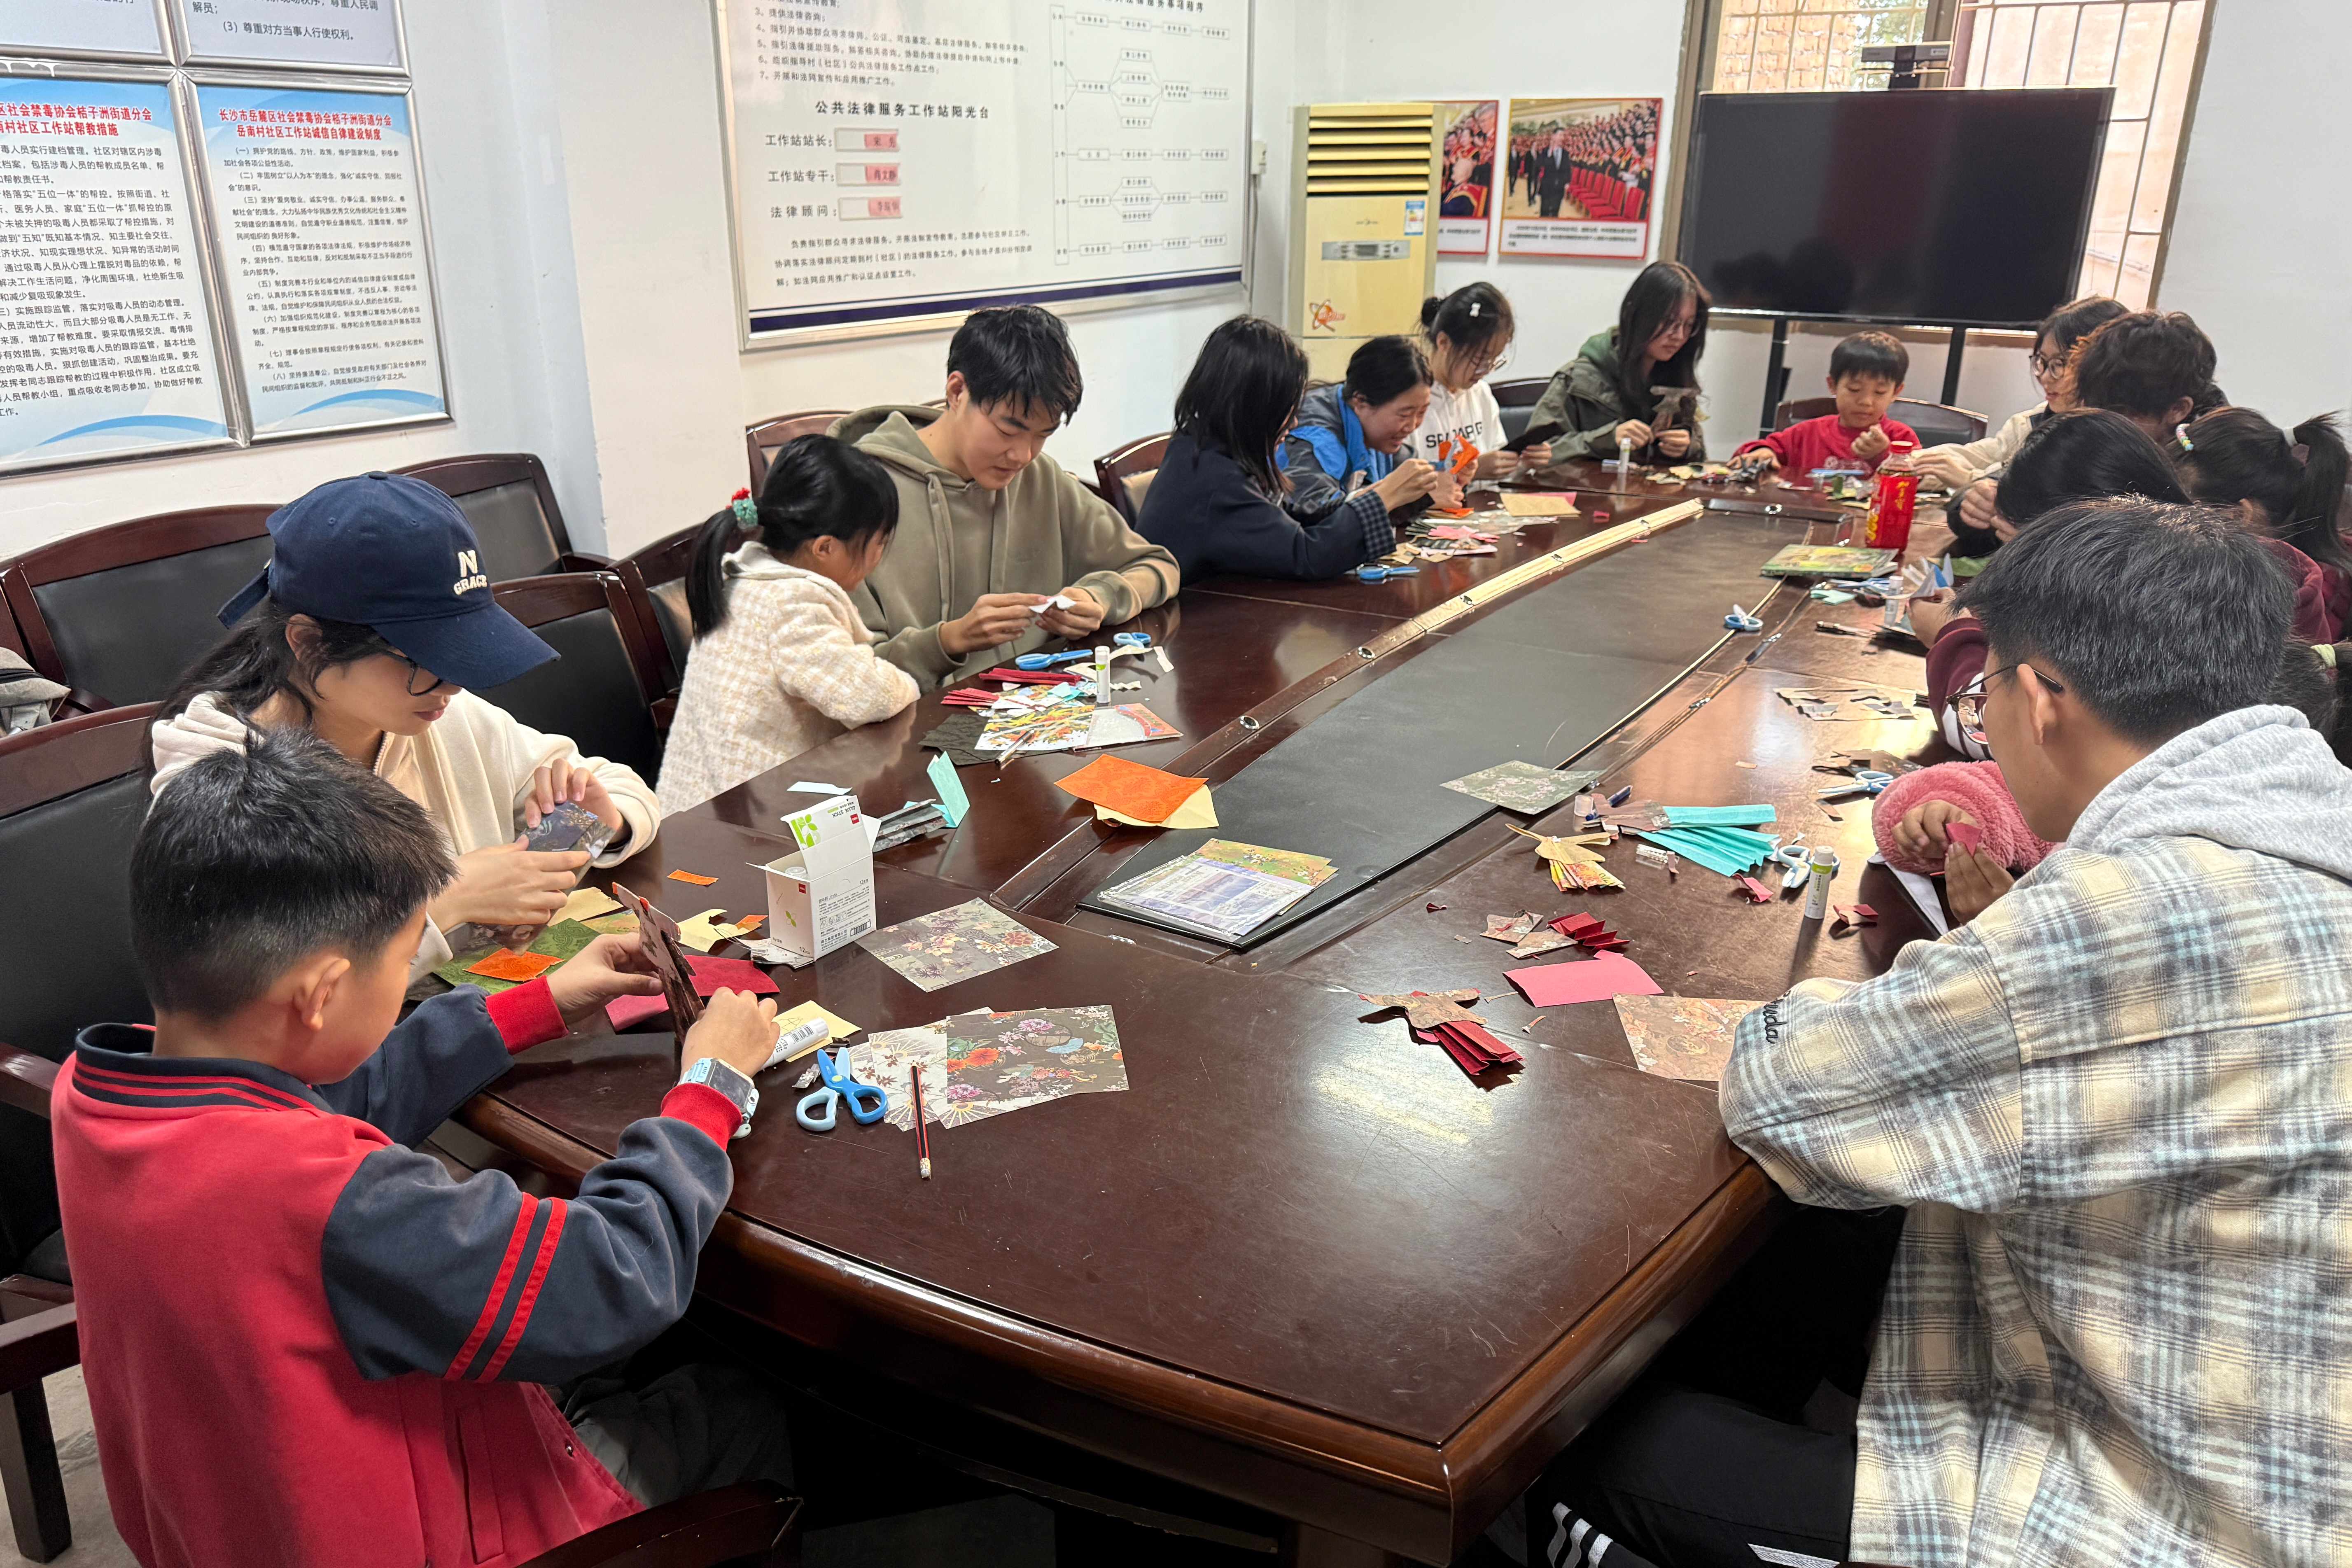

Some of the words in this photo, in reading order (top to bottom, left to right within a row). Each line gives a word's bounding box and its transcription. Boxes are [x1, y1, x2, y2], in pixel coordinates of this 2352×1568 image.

[193, 1, 218, 14] 解员；
[815, 100, 989, 119] 公共法律服务工作站阳光台
[236, 125, 382, 141] 岳南村社区工作站诚信自律建设制度
[0, 160, 164, 170] 档案，包括涉毒人员的帮教成员名单、帮
[0, 189, 170, 199] 格落实“五位一体”的帮控。按照街道、社
[0, 244, 179, 257] 济状况、知现实理想状况、知异常的活动时间
[0, 377, 203, 402] 人员帮教小组，重点吸收老同志参加，协助做好帮教
[458, 550, 478, 578] N
[453, 575, 488, 595] GRACE
